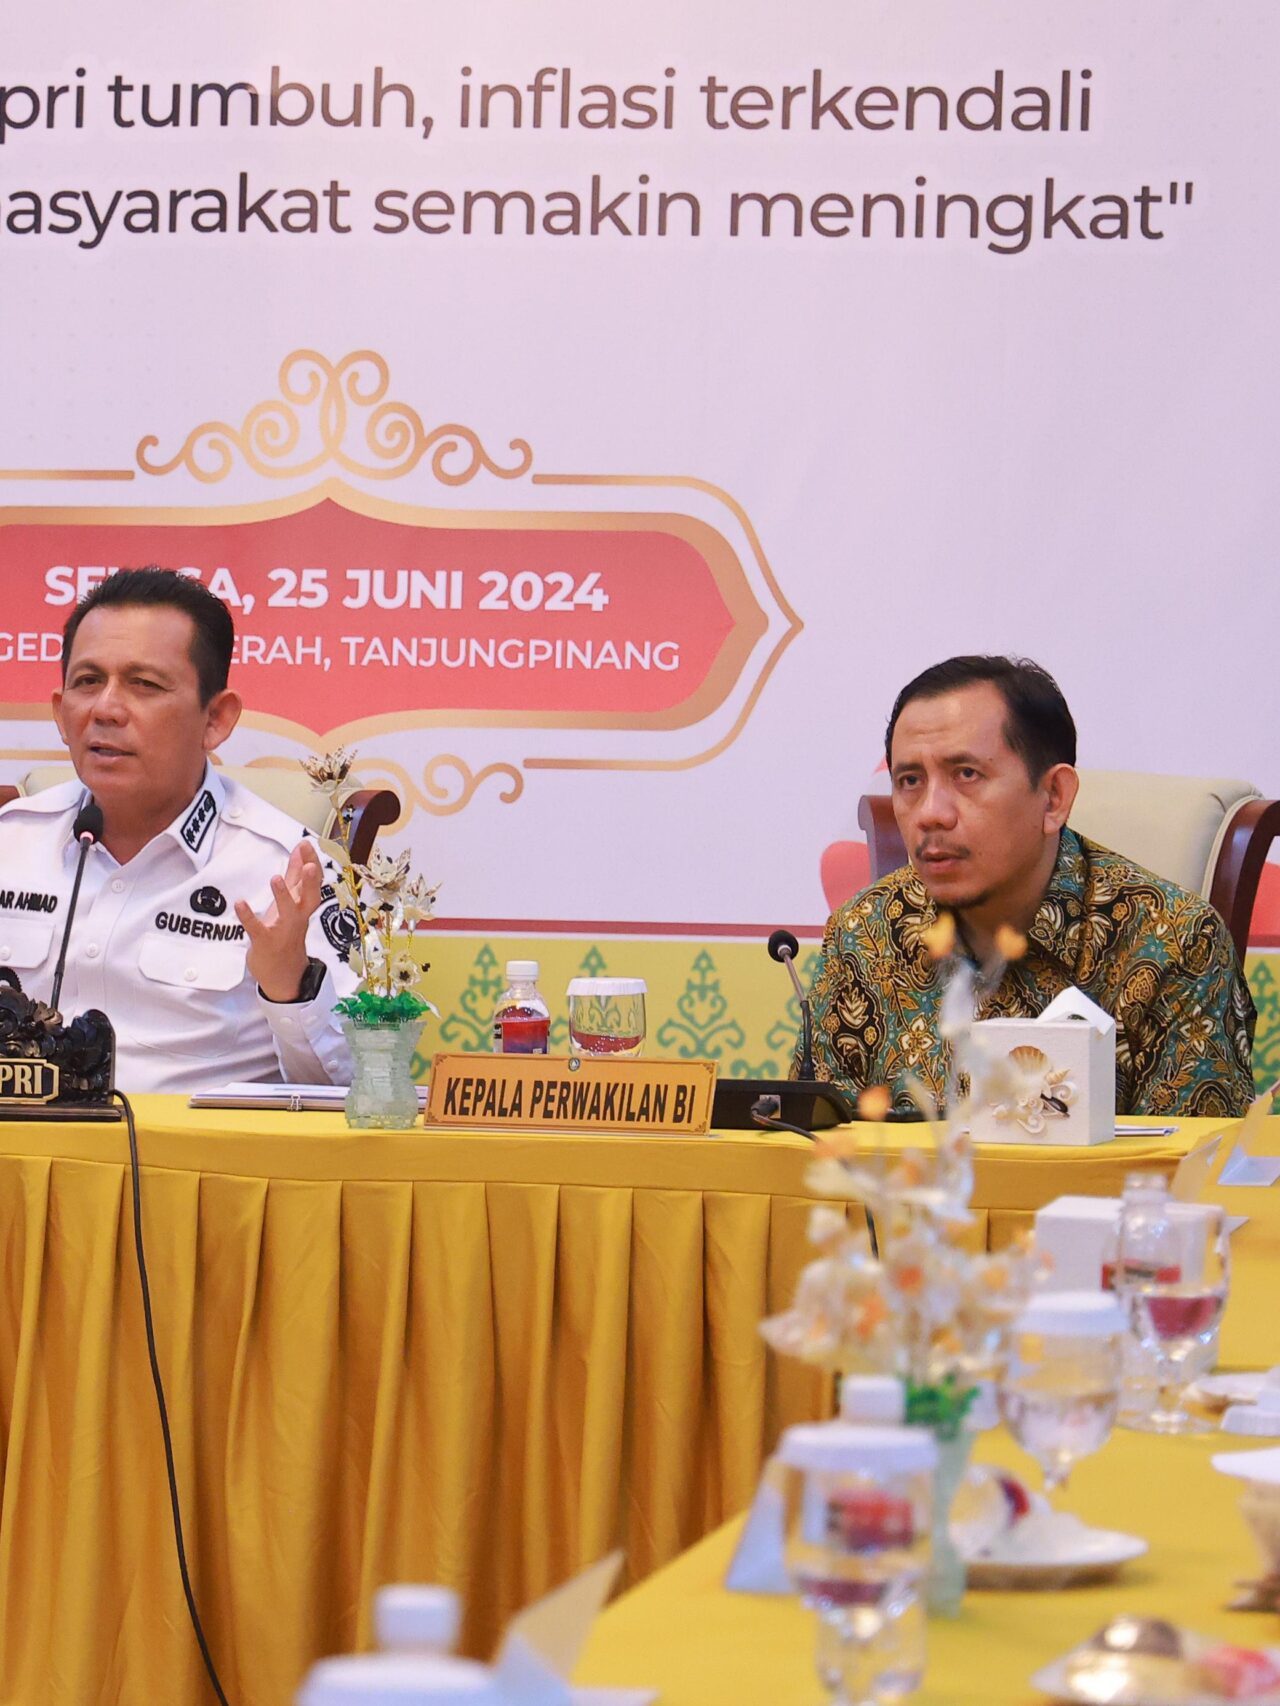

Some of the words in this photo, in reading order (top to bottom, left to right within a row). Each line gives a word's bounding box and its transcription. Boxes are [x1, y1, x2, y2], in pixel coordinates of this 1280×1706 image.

[107, 66, 433, 139] tumbuh,
[460, 66, 676, 130] inflasi
[699, 68, 1093, 132] terkendali
[373, 174, 701, 237] semakin
[729, 176, 1194, 255] meningkat"
[45, 566, 255, 615] SEA,
[267, 568, 329, 608] 25
[342, 569, 464, 609] JUNI
[478, 571, 610, 612] 2024
[341, 636, 680, 671] TANJUNGPINANG
[155, 912, 245, 941] GUBERNUR
[443, 1077, 522, 1118] KEPALA
[529, 1080, 669, 1123] PERWAKILAN
[672, 1084, 696, 1124] BI
